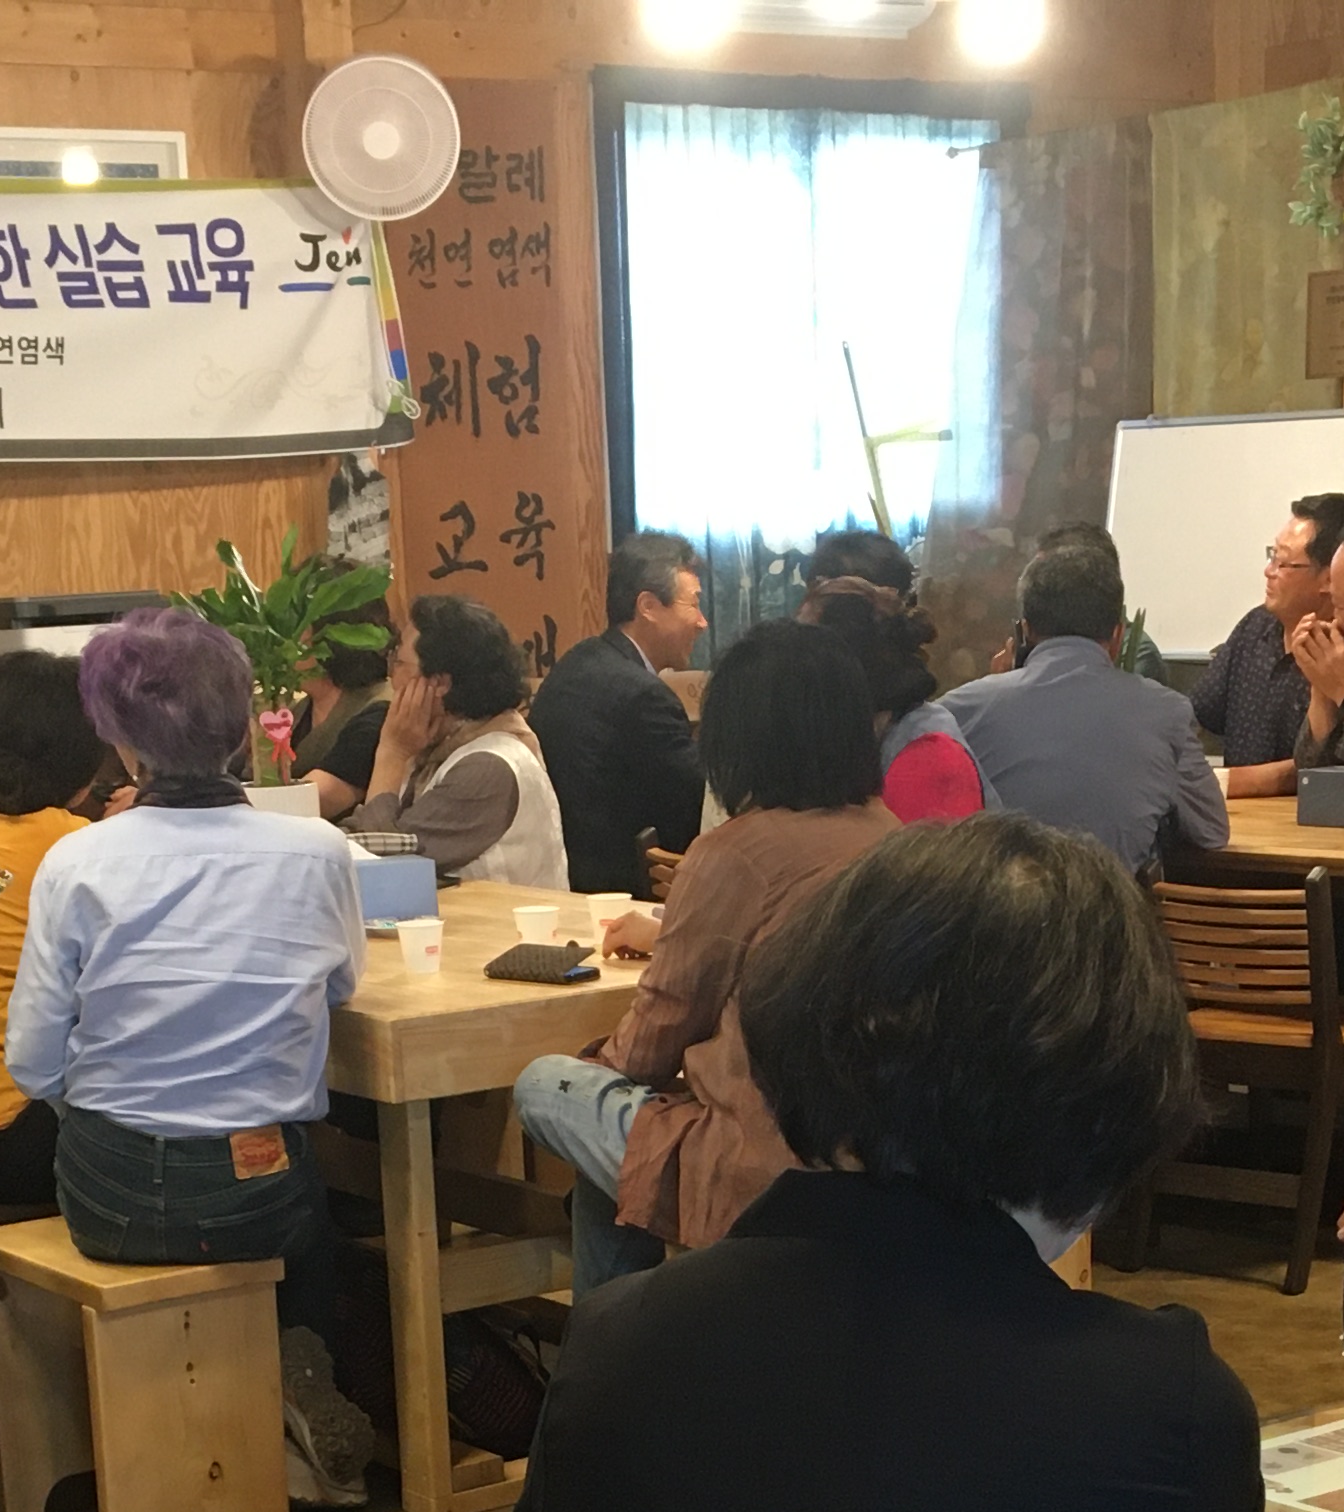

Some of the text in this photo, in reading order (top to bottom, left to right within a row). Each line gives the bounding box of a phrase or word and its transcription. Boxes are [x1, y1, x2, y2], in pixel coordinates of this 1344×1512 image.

[457, 145, 545, 204] 말례
[44, 221, 151, 309] 실습
[155, 217, 255, 310] 교육
[407, 220, 552, 290] 천연 염색
[420, 334, 542, 439] 체험
[428, 490, 556, 582] 교육
